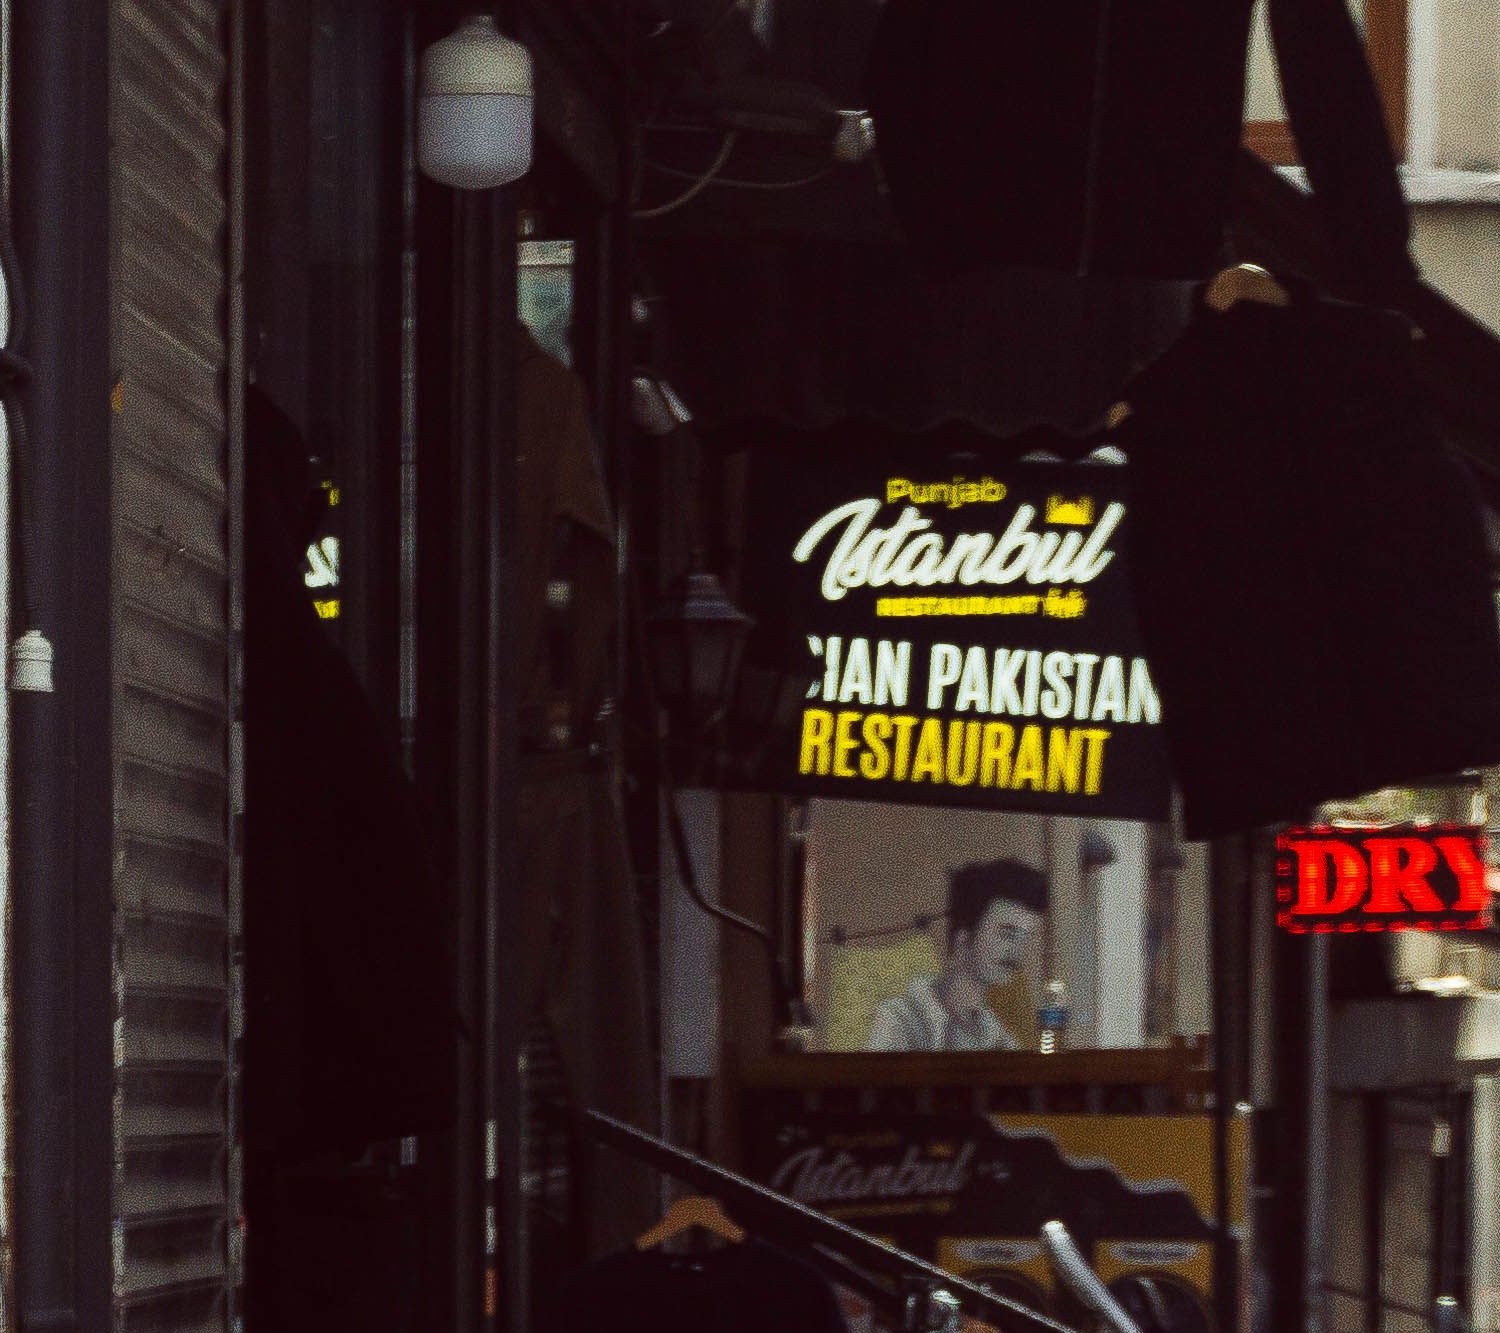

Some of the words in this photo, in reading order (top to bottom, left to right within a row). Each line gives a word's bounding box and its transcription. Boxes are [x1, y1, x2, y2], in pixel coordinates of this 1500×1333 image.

[886, 476, 1008, 510] Punjab
[792, 498, 1127, 601] Istanbul
[806, 634, 912, 707] IAN
[798, 708, 1112, 797] RESTAURANT
